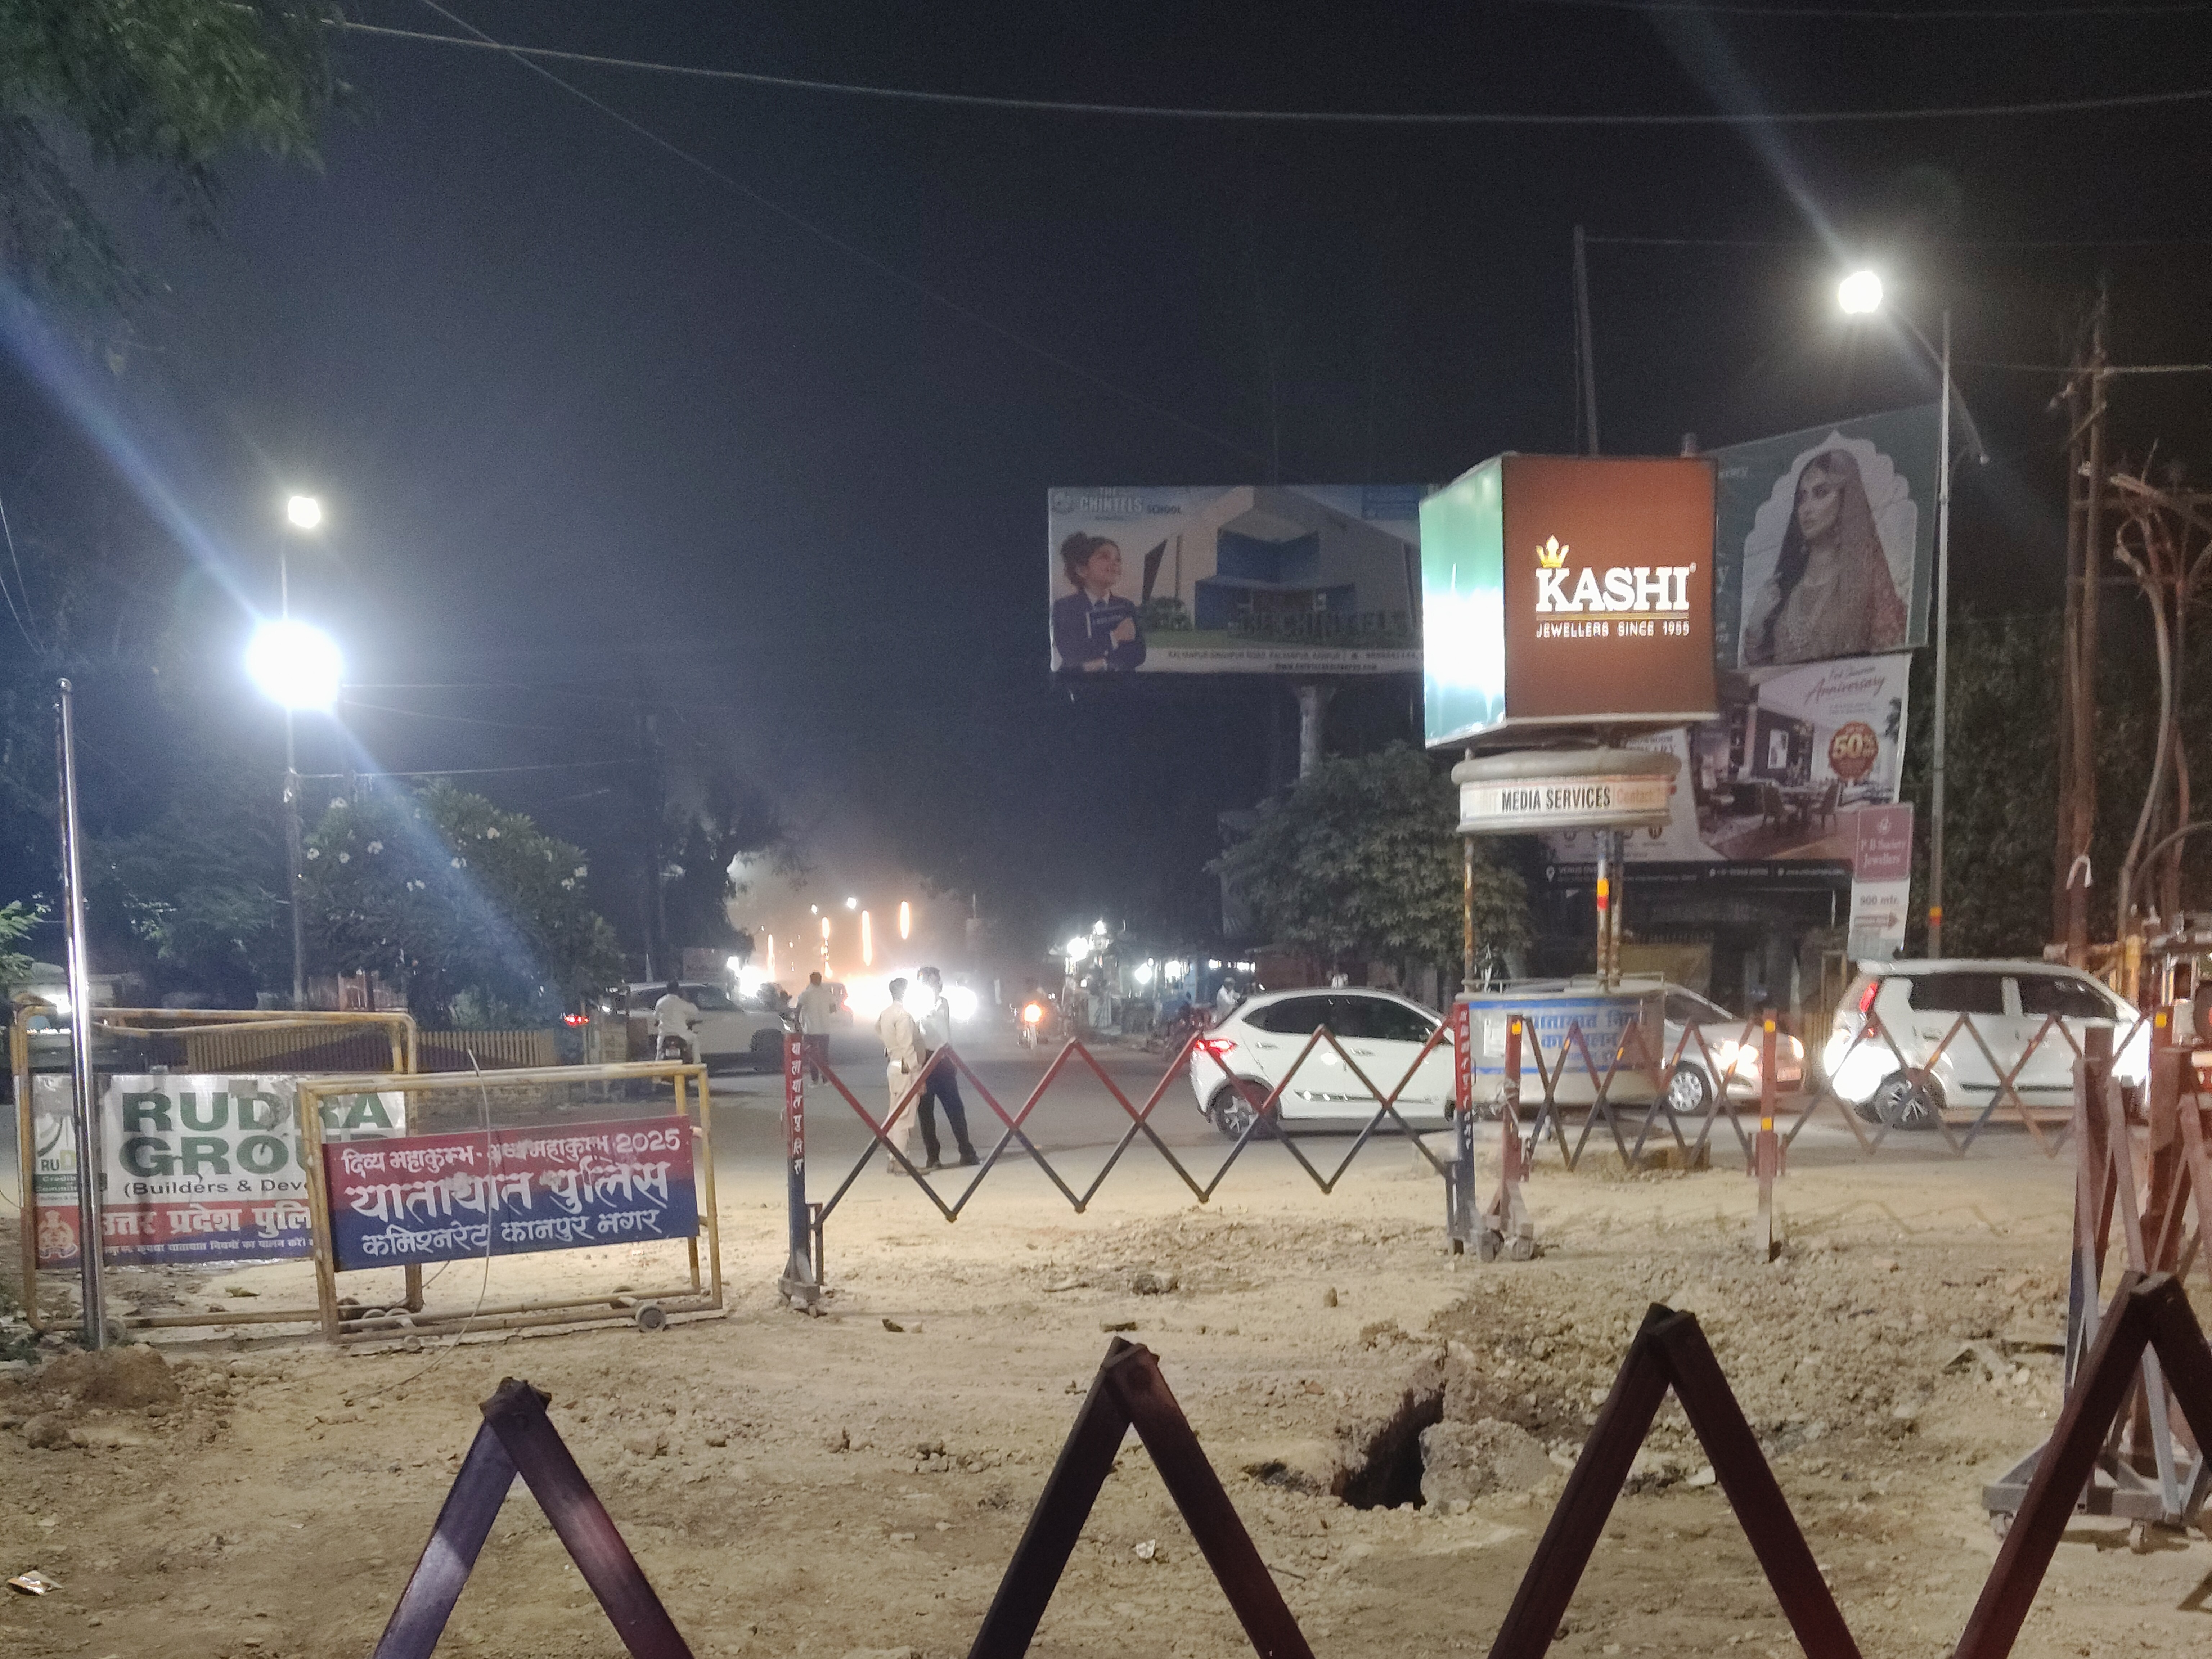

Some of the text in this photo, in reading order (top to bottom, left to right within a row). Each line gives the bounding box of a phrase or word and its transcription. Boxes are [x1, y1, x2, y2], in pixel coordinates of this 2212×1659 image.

[1536, 566, 1689, 612] KASHI
[1536, 621, 1609, 638] JEWELLERS
[1618, 621, 1654, 637] SINCE
[1502, 789, 1541, 813] MEDIA
[1546, 786, 1611, 811] SERVICES
[341, 1148, 385, 1178] दिव्य
[615, 1128, 680, 1153] 2025
[125, 1180, 228, 1198] (Builders
[238, 1179, 252, 1192] &
[345, 1155, 670, 1224] यातायात पुलिस
[167, 1202, 242, 1234] प्रदेश
[252, 1200, 311, 1238] पुलि
[361, 1209, 663, 1257] कमिश्नरेट कानपुर नगर
